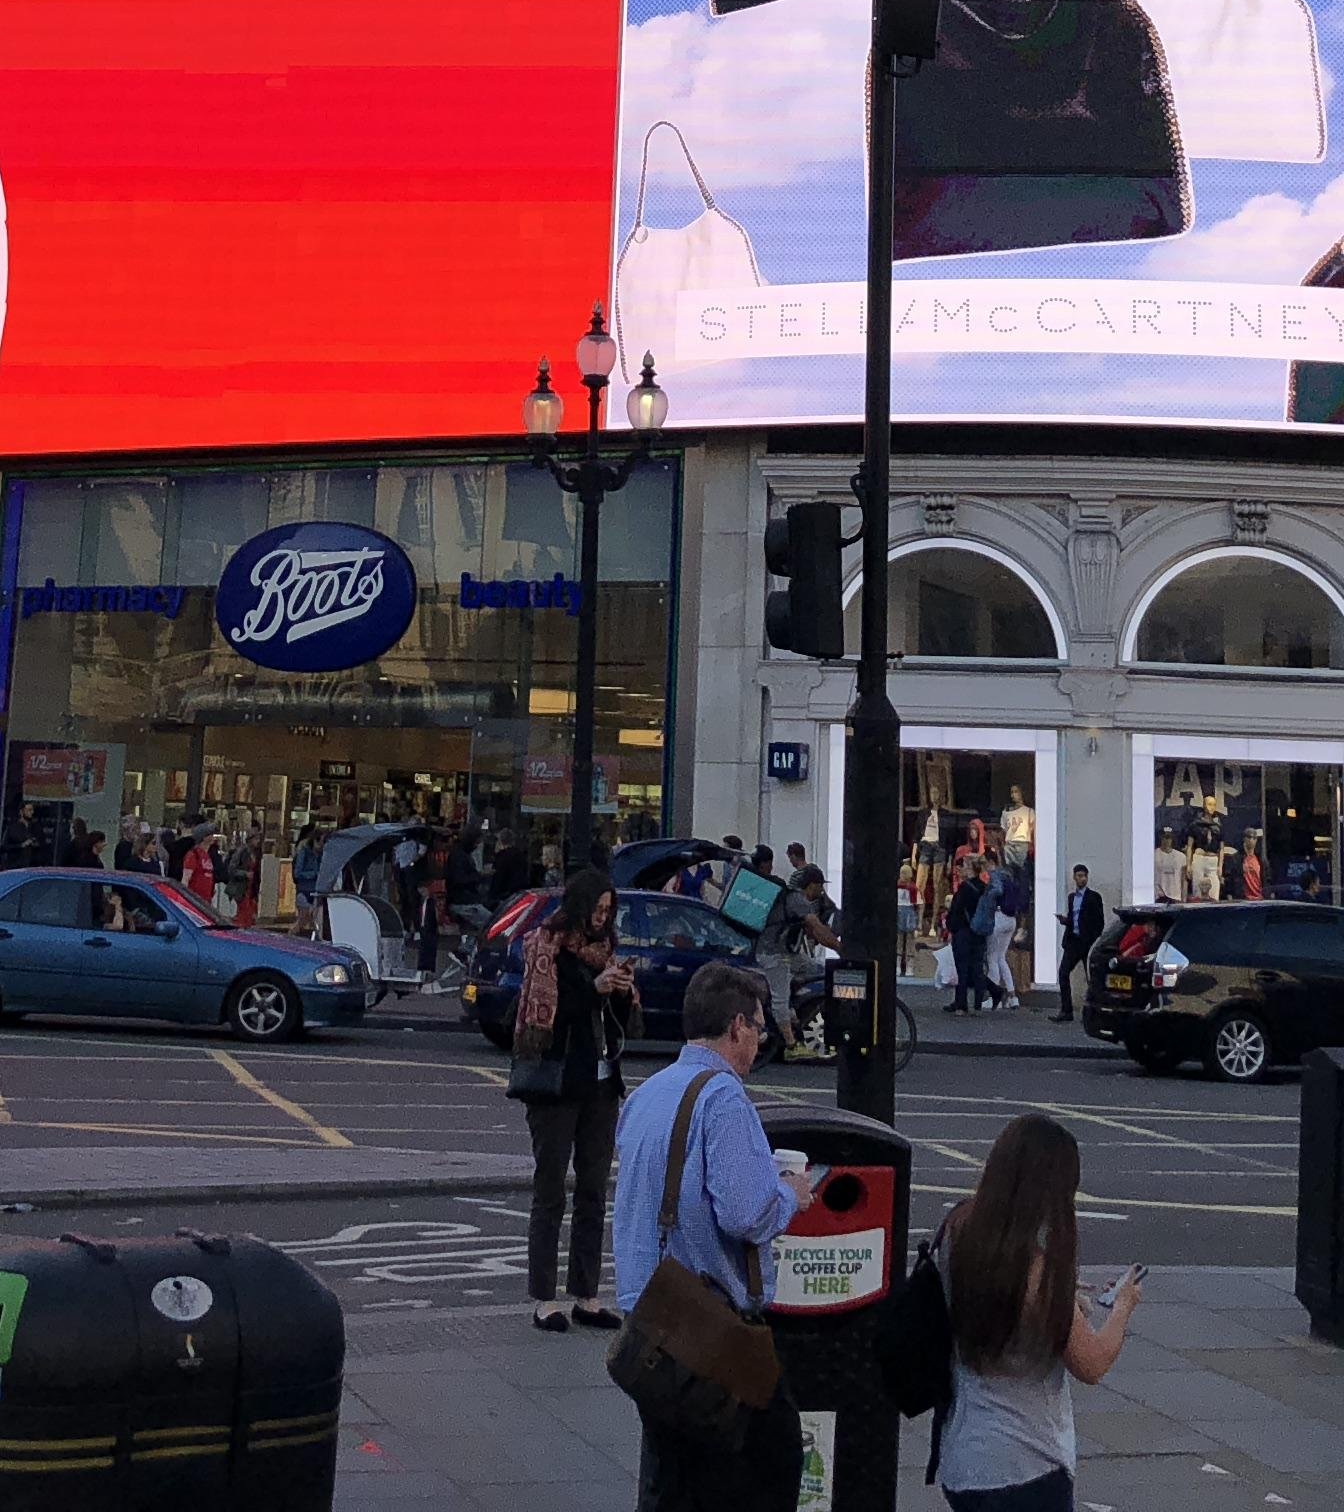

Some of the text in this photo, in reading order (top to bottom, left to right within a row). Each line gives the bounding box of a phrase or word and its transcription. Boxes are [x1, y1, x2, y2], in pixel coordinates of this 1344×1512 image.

[21, 576, 187, 620] pharmacy
[230, 546, 385, 643] Boots
[460, 571, 583, 617] beauty
[773, 751, 794, 768] GAP
[783, 1248, 873, 1262] RECYCLE YOUR
[792, 1262, 863, 1275] COFFEE CUP
[802, 1275, 850, 1295] HERE
